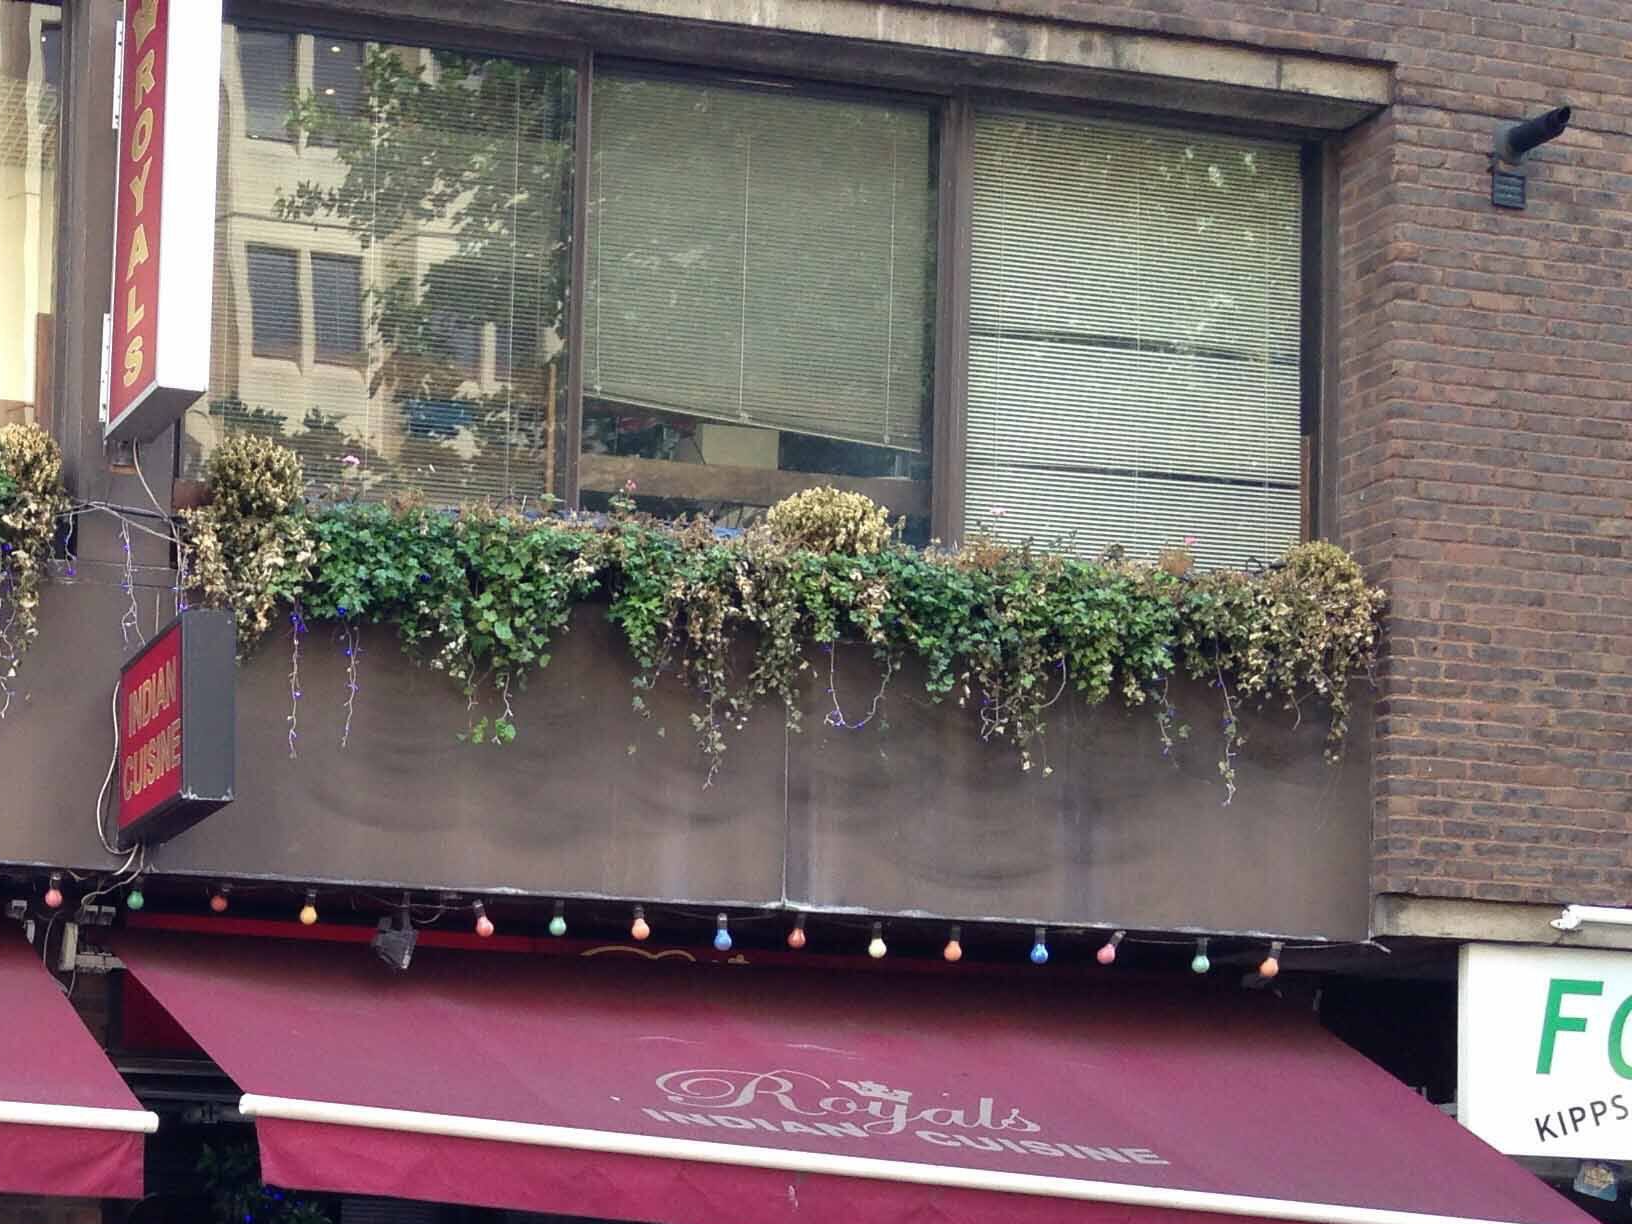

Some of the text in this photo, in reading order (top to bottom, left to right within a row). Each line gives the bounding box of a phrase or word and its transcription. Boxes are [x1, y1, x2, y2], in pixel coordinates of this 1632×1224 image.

[123, 48, 156, 387] ROYALS
[128, 655, 176, 737] INDIAN
[122, 718, 181, 800] CUISINE
[642, 1107, 1170, 1165] INDIAN CUISINE
[655, 1068, 1041, 1135] Royals
[1534, 1094, 1629, 1142] KIPPS
